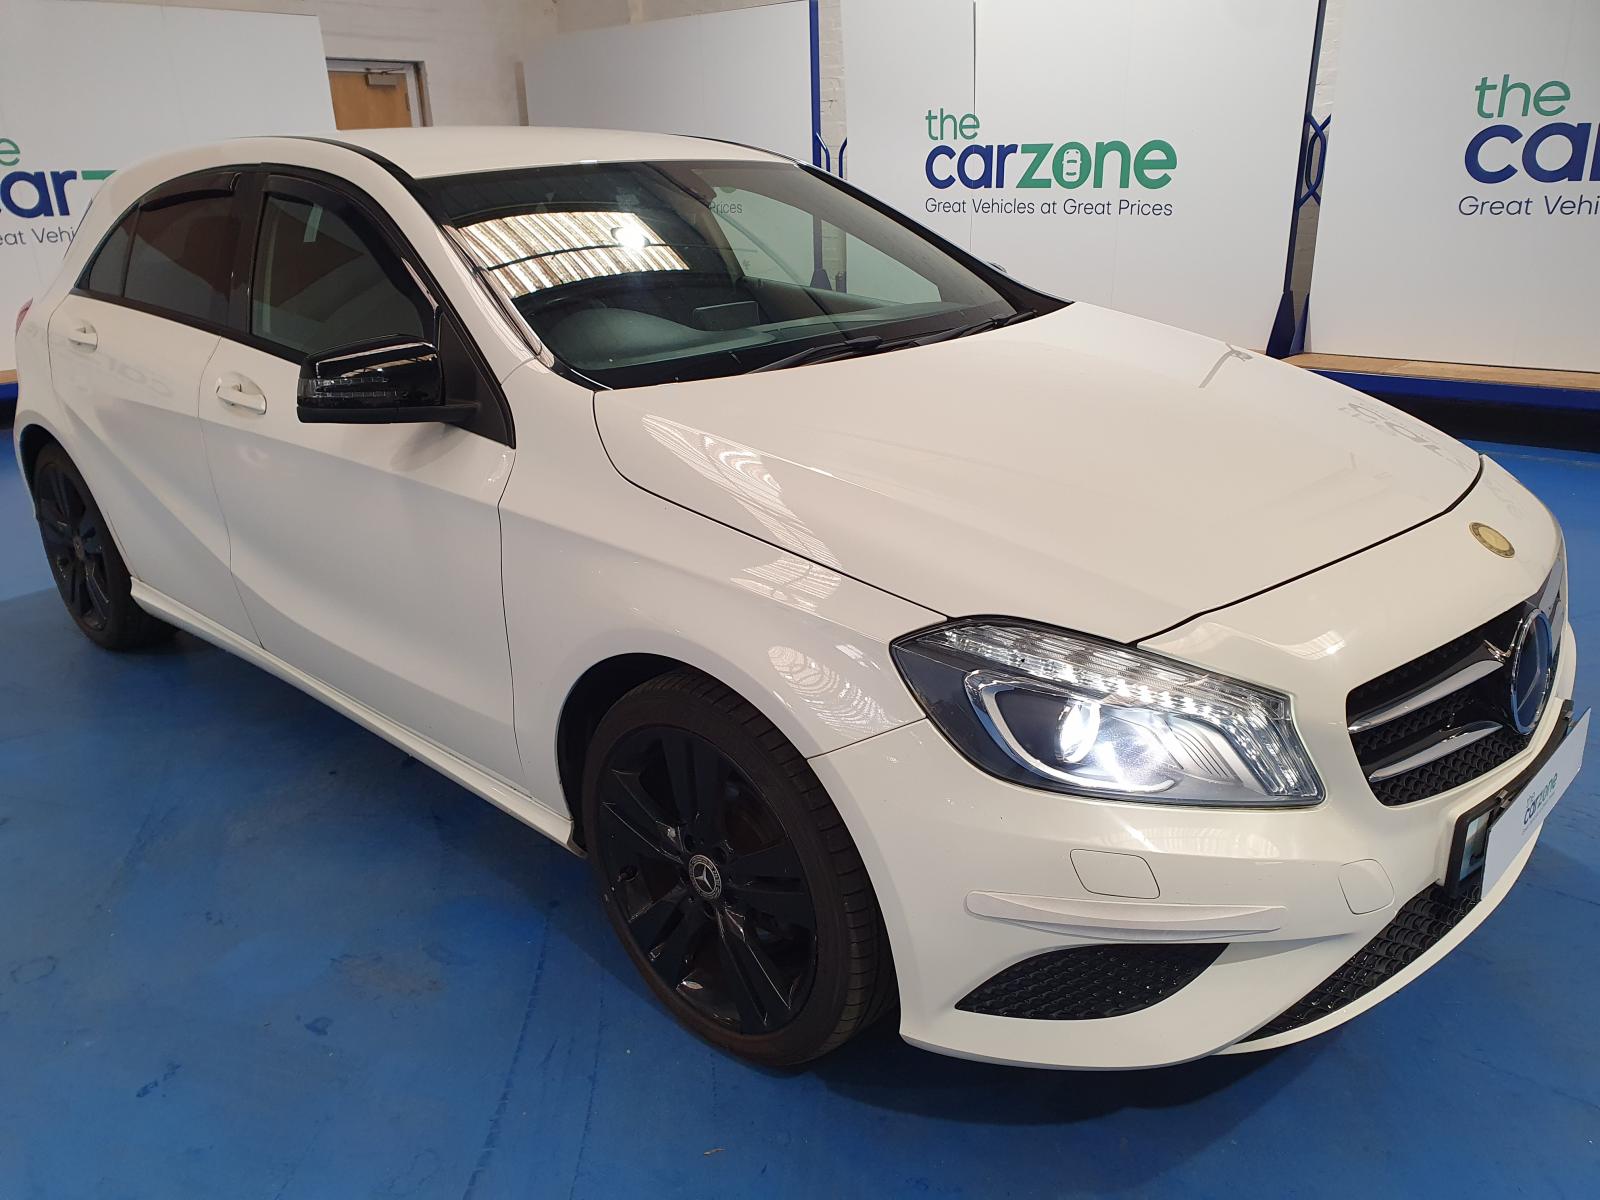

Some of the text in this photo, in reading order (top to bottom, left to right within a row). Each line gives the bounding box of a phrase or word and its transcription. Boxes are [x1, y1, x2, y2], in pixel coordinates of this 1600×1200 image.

[1475, 74, 1571, 119] the
[925, 108, 980, 140] the
[925, 139, 1177, 190] carzone
[0, 170, 118, 219] ar
[925, 198, 1173, 216] Great Vehicles at Great Prices
[1458, 195, 1533, 216] Great
